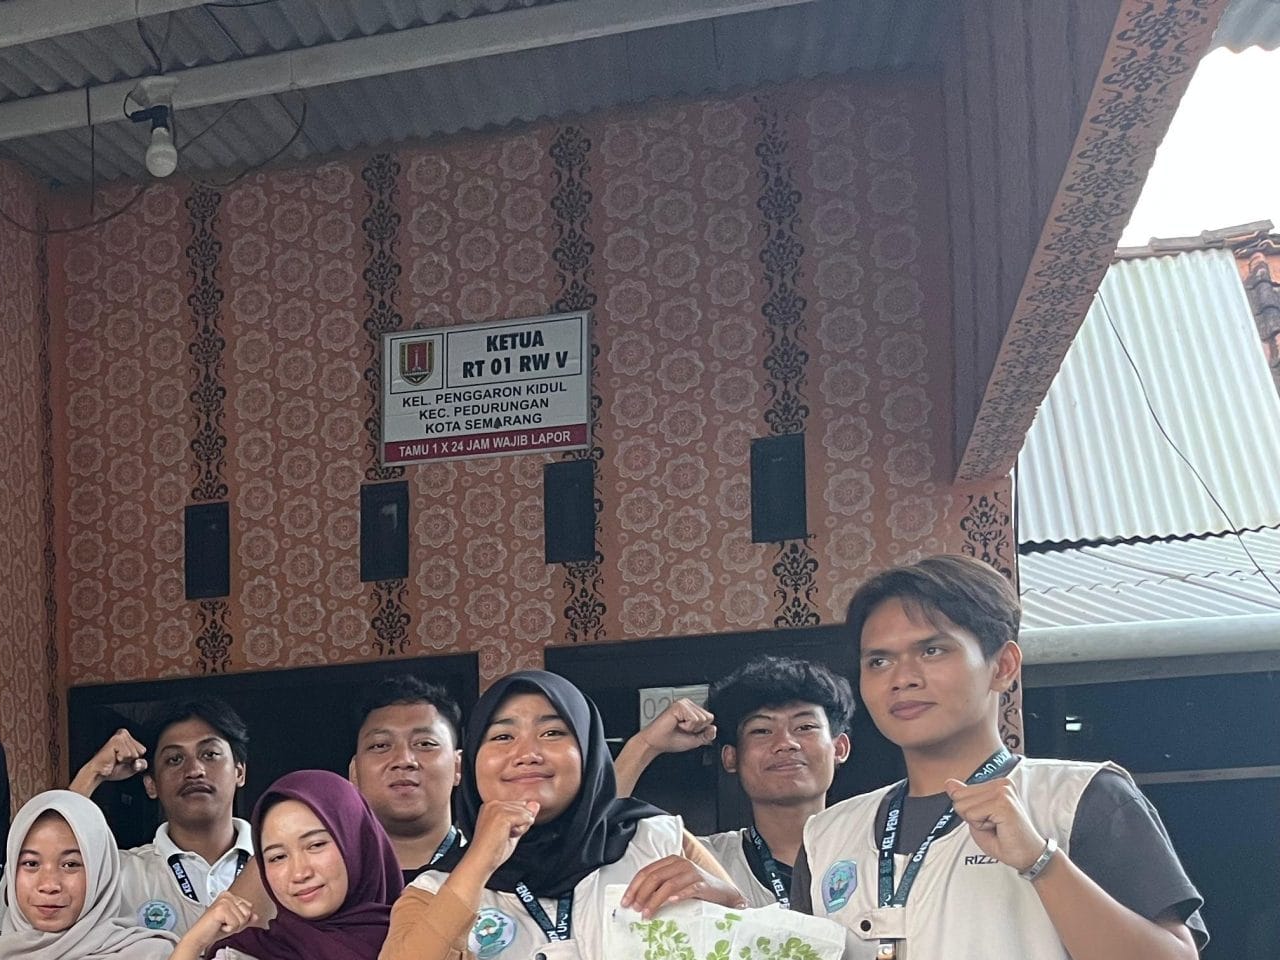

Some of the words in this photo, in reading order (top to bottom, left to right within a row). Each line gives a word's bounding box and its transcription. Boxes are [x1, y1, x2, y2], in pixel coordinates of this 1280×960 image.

[486, 330, 545, 352] KETUA
[462, 359, 485, 379] RT
[490, 357, 511, 375] 01
[519, 353, 551, 373] RW
[555, 351, 569, 369] V
[402, 396, 432, 408] KEL.
[435, 386, 522, 404] PENGGARON
[526, 382, 567, 395] KIDUL
[419, 407, 450, 420] KEC.
[453, 397, 549, 416] PEDURUNGAN
[425, 420, 462, 434] KOTA
[464, 412, 542, 431] SEMARANG
[399, 445, 429, 458] TAMU
[432, 443, 438, 454] 1
[440, 442, 449, 454] X
[450, 441, 464, 453] 24
[466, 438, 490, 451] JAM
[492, 434, 528, 449] WAJIB
[531, 430, 571, 447] LAPOR
[965, 855, 999, 865] RIZZ
